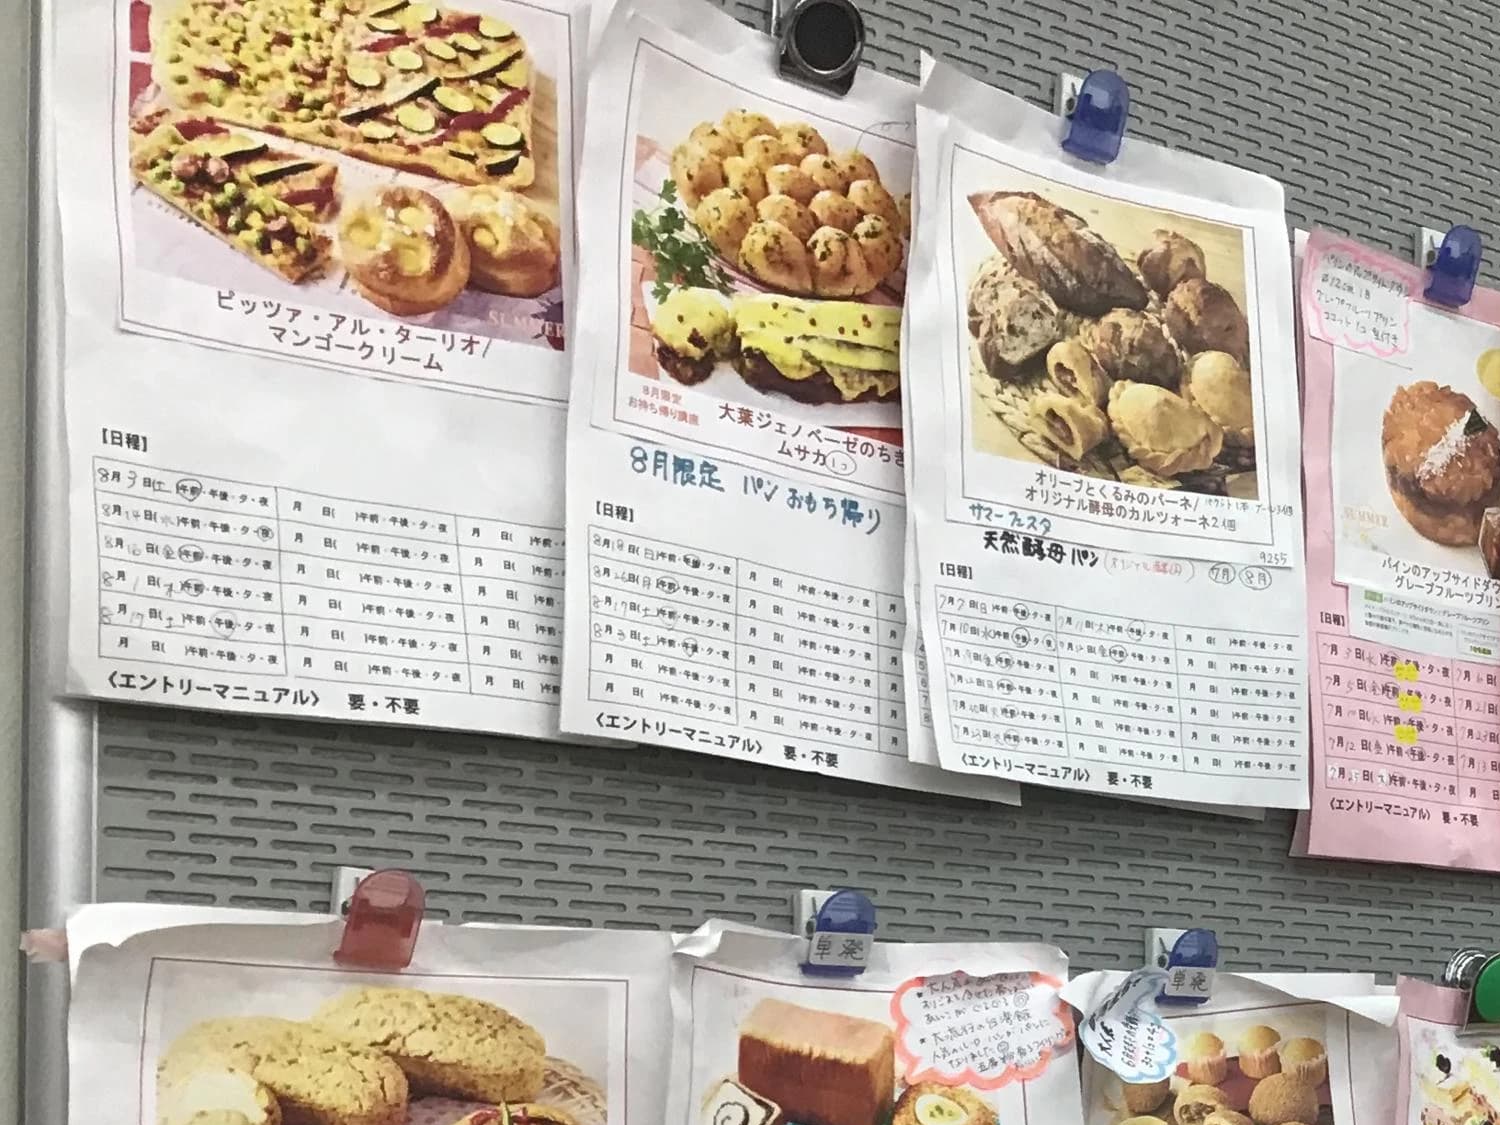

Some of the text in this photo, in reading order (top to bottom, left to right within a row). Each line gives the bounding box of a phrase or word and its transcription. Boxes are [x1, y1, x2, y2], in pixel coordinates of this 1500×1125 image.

[216, 291, 492, 358] ピッツァ・アル・ターリオ/
[270, 325, 443, 372] マンゴークリーム
[630, 446, 725, 493] 8月限定
[777, 441, 827, 467] ムサカ
[348, 693, 420, 715] 要・不要
[784, 744, 839, 769] 要・不要
